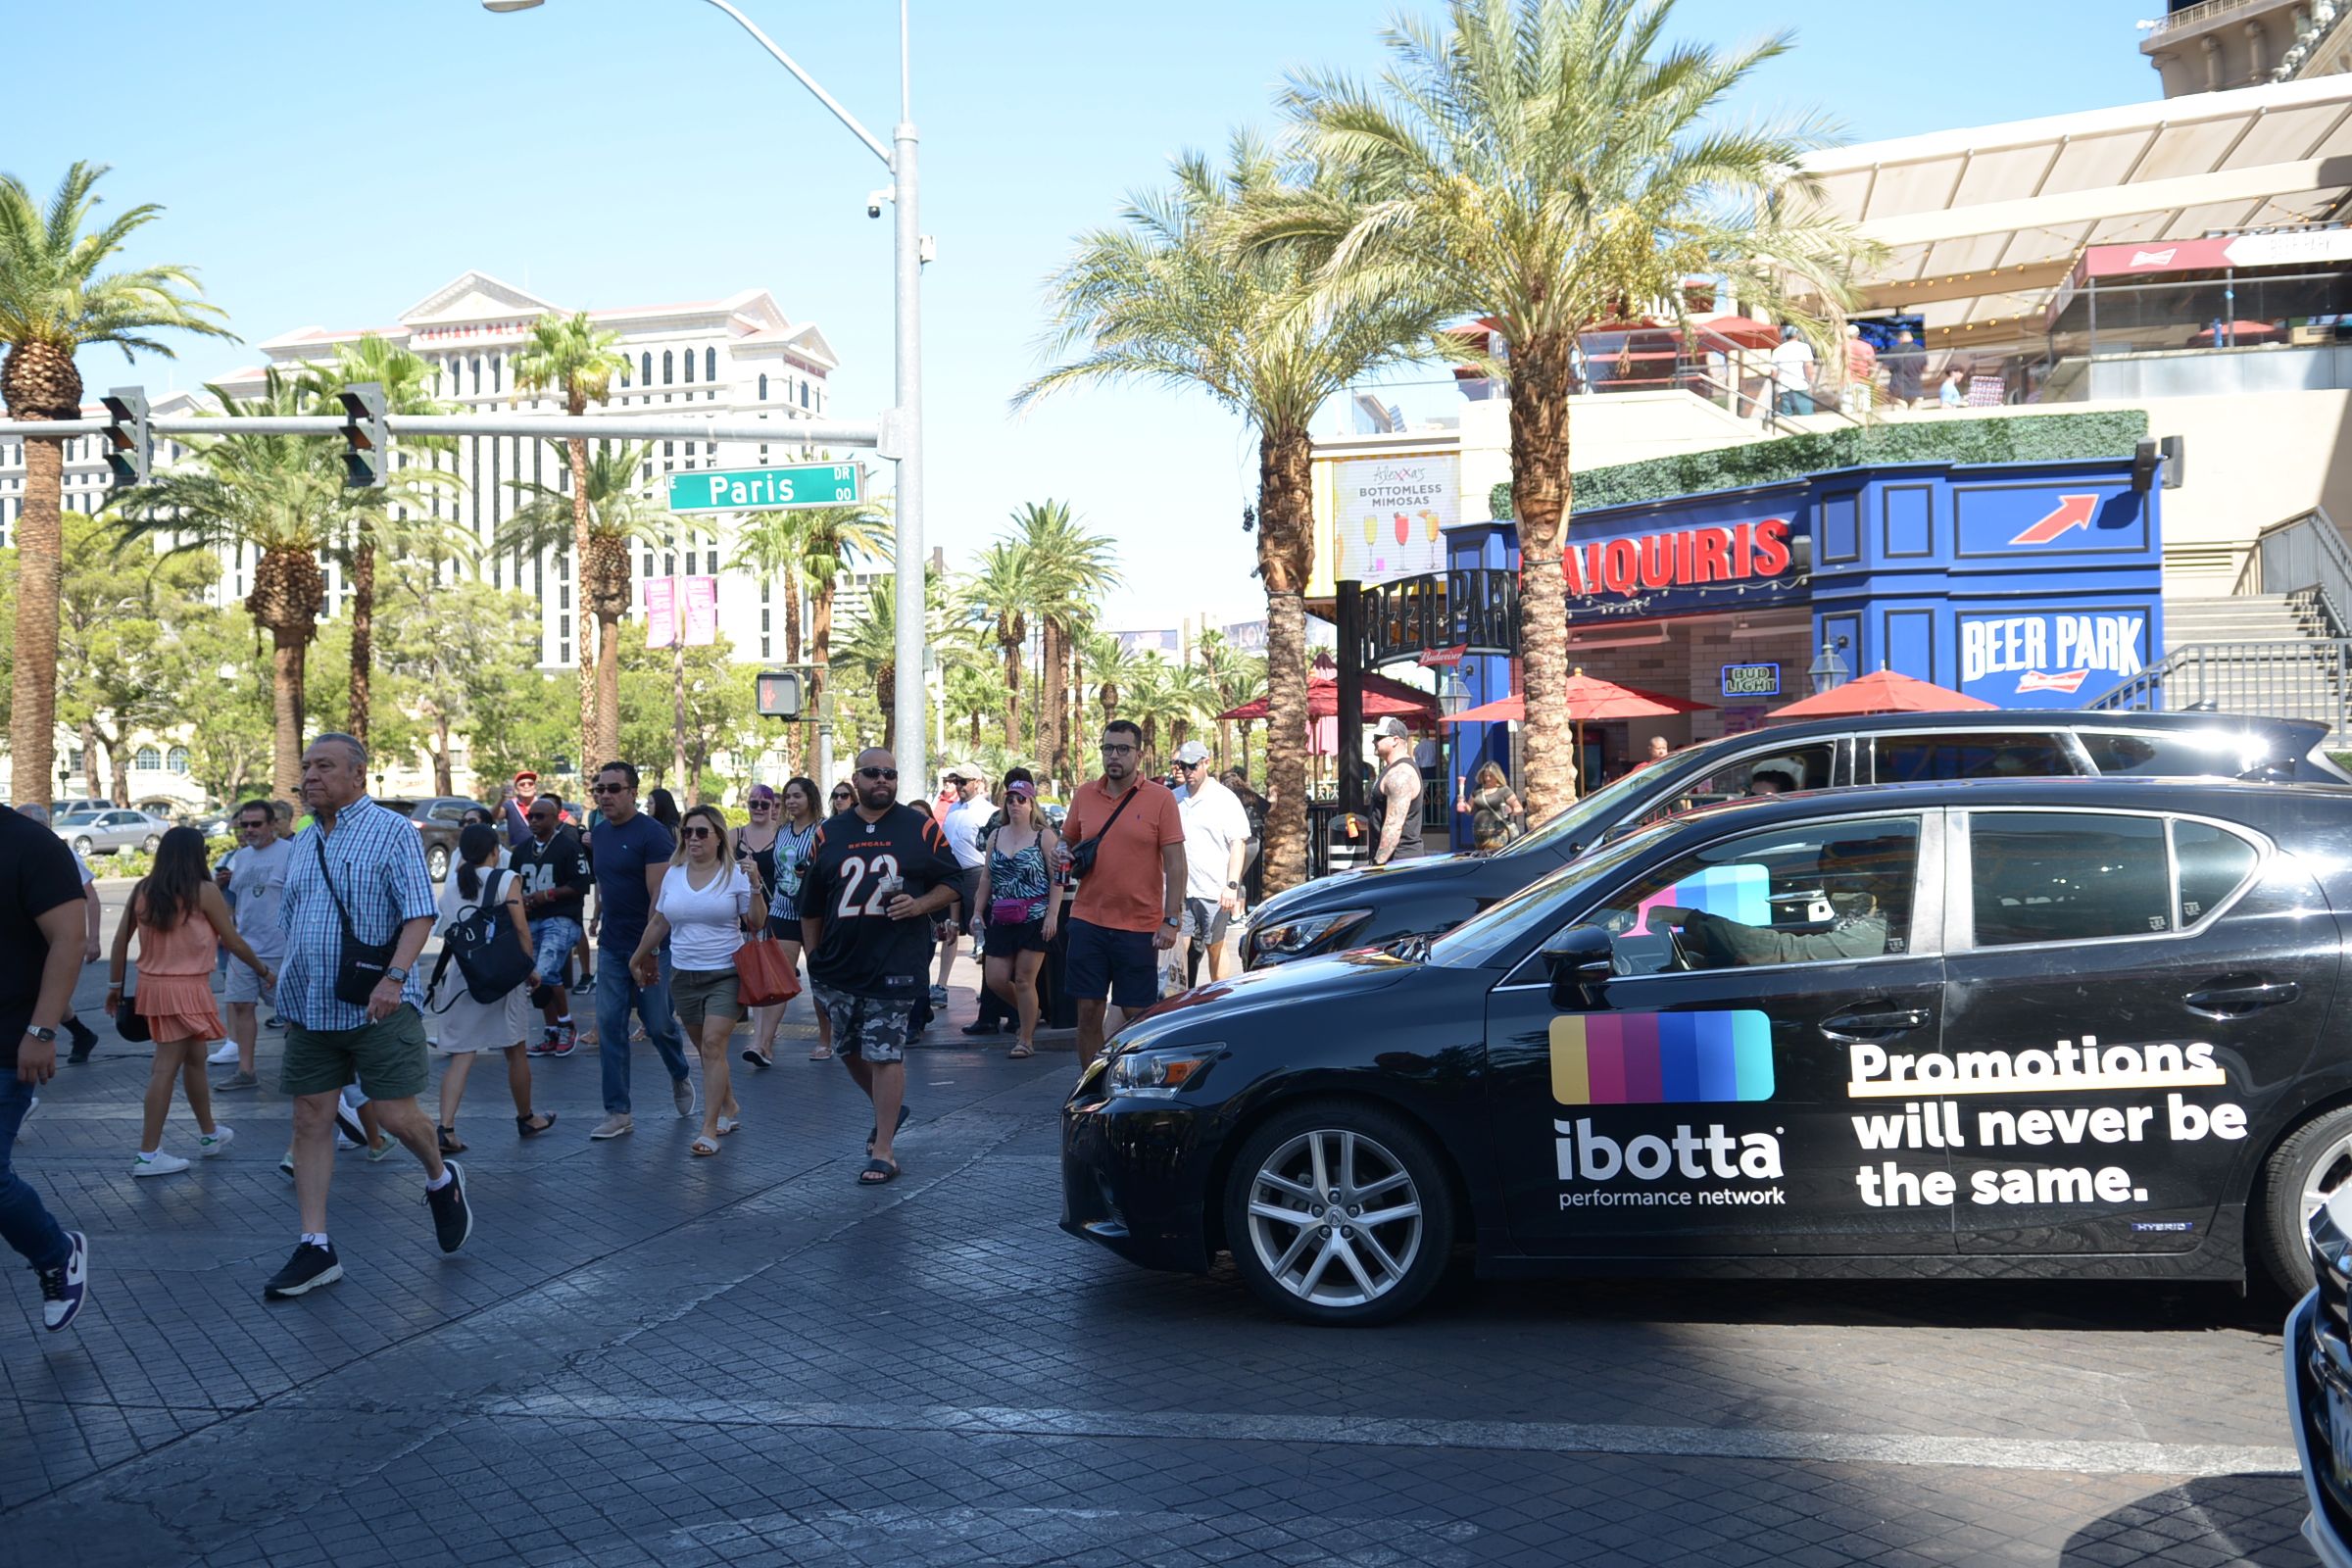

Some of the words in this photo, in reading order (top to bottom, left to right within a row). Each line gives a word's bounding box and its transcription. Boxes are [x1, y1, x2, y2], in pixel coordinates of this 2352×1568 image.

[668, 475, 677, 489] E
[709, 472, 796, 506] Paris
[833, 466, 851, 481] DR
[835, 487, 852, 501] 00
[1359, 483, 1443, 498] BOTTOMLESS
[1372, 495, 1430, 508] MIMOSAS
[1518, 518, 1790, 599] AIQUIRIS
[1362, 572, 1439, 668] BEER
[1239, 624, 1269, 648] LOV
[1961, 615, 2048, 683] BEER
[2055, 614, 2144, 677] PARK
[1420, 651, 1463, 663] Budweiser
[1726, 678, 1776, 693] LIGHT
[1732, 666, 1770, 679] BUD
[848, 840, 893, 850] BENGALS
[520, 863, 556, 897] 34
[838, 854, 899, 918] 22
[1849, 1035, 2217, 1083] Promotions
[1851, 1101, 1965, 1150] will
[1978, 1105, 2153, 1147] never
[2167, 1093, 2248, 1142] be
[1553, 1117, 1785, 1181] ibotta
[1559, 1189, 1692, 1210] performance
[1698, 1186, 1787, 1205] network
[1856, 1161, 1957, 1207] the
[1971, 1165, 2149, 1206] same.
[2137, 1222, 2186, 1232] HYBRID
